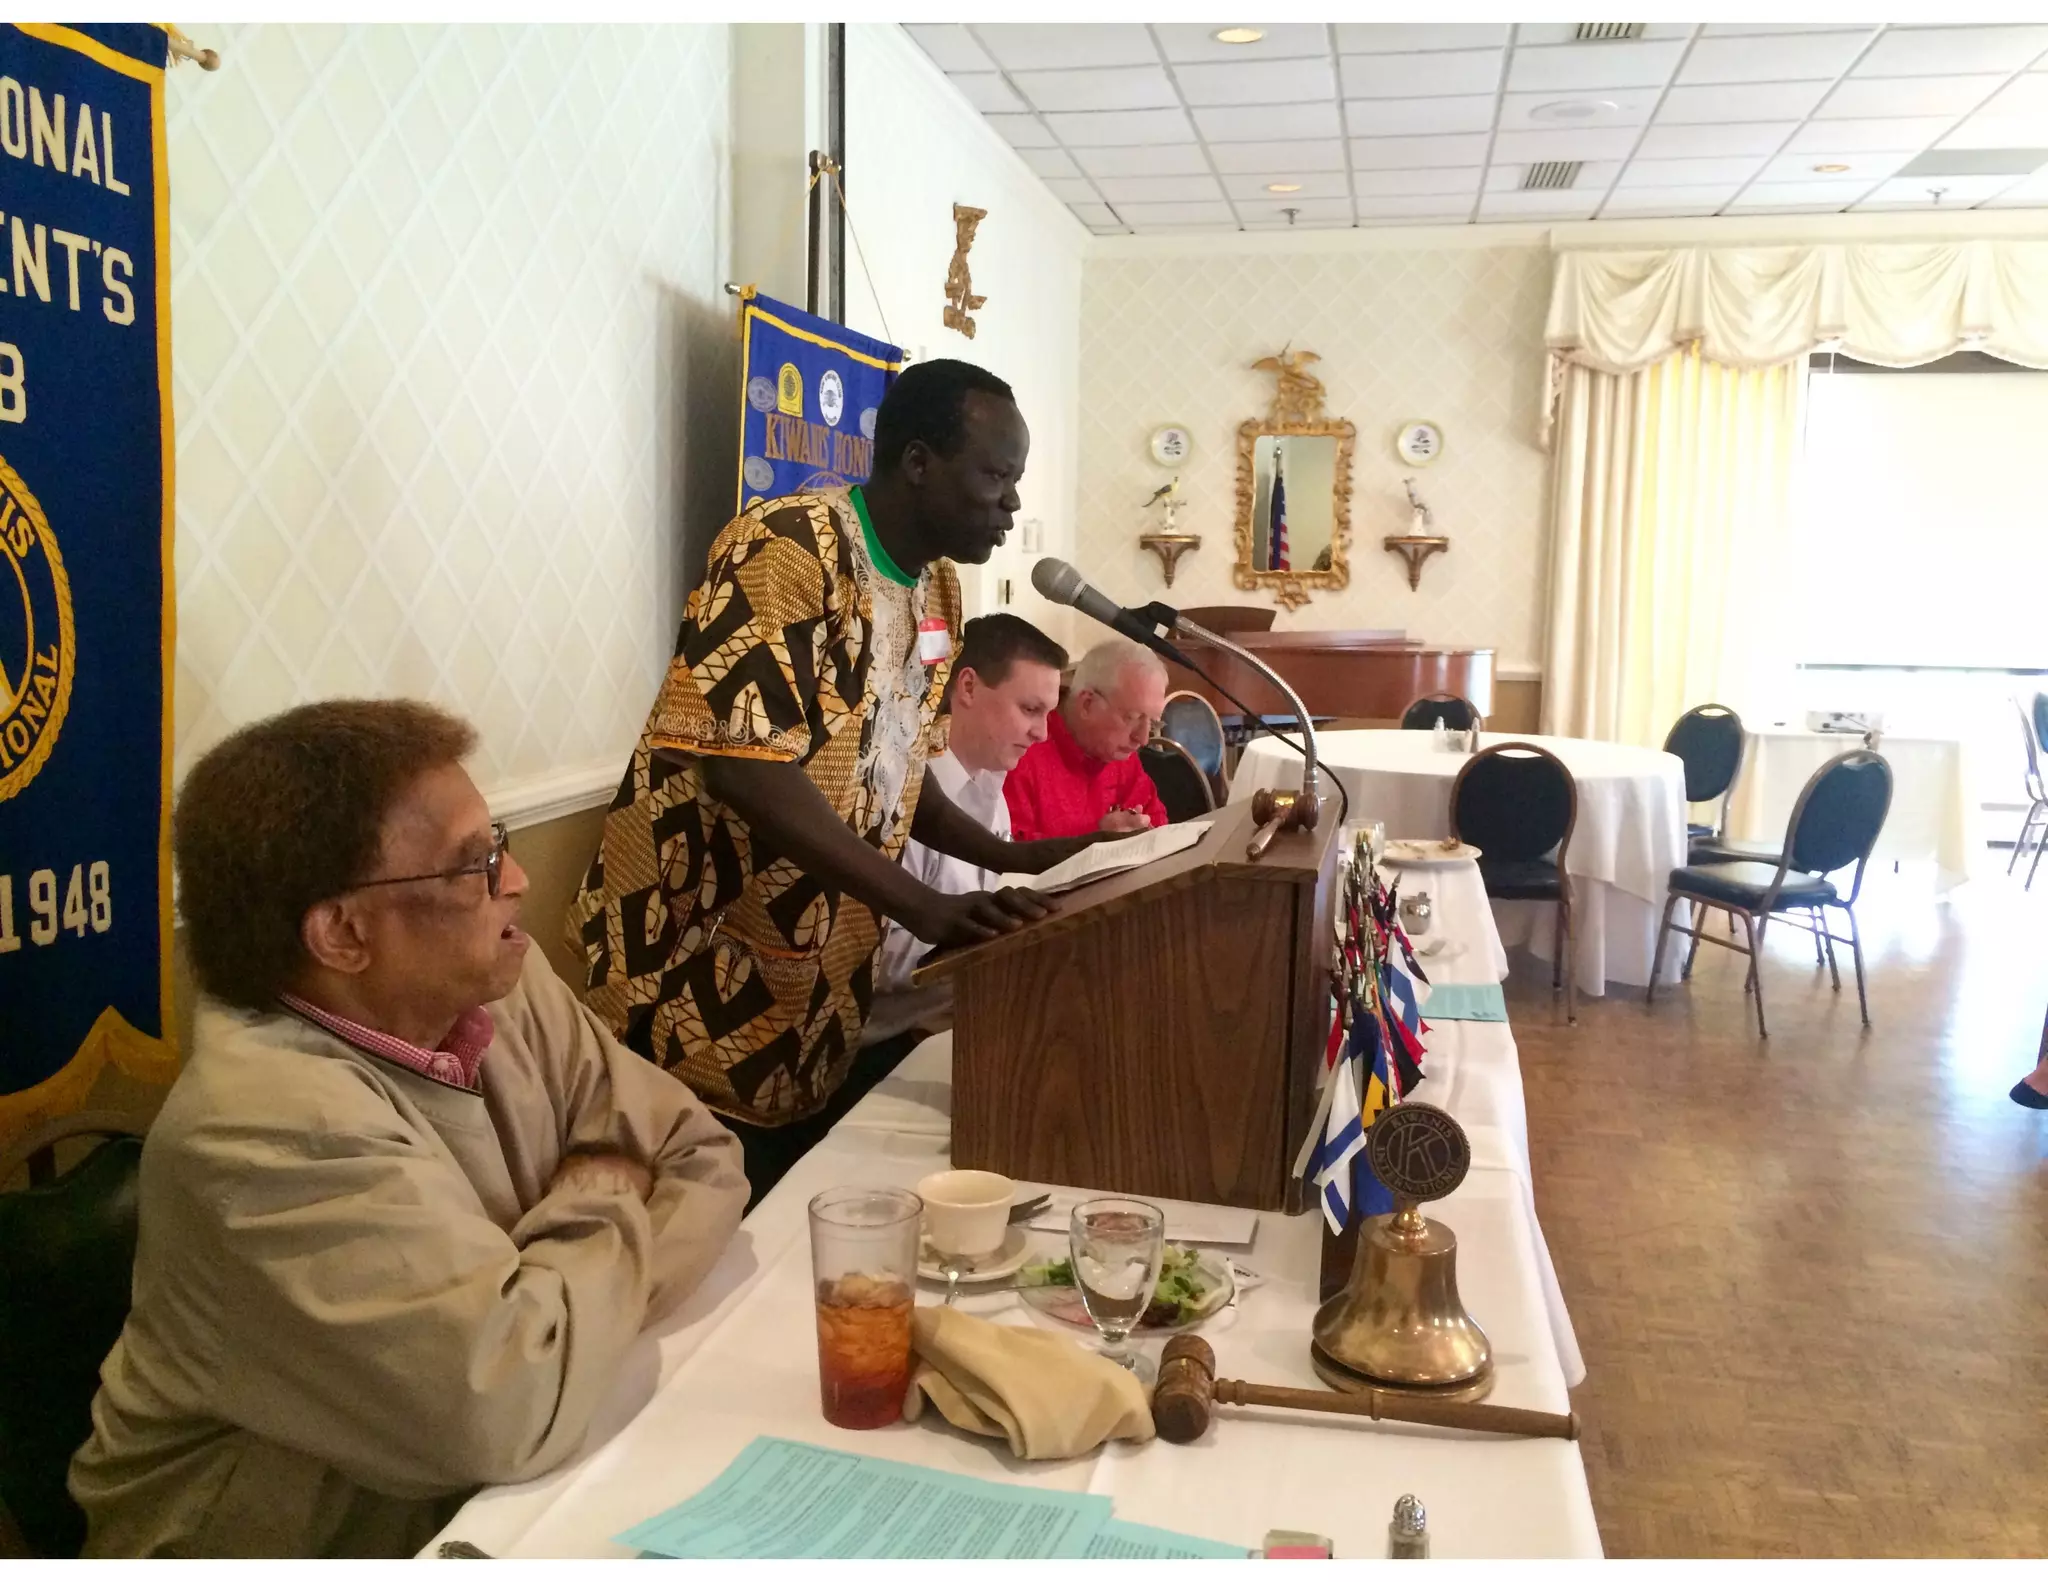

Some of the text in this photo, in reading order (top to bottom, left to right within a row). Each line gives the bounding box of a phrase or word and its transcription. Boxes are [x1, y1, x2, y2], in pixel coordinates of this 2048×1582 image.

[0, 75, 130, 197] ONAL
[0, 487, 36, 558] IS
[0, 860, 112, 953] 1948
